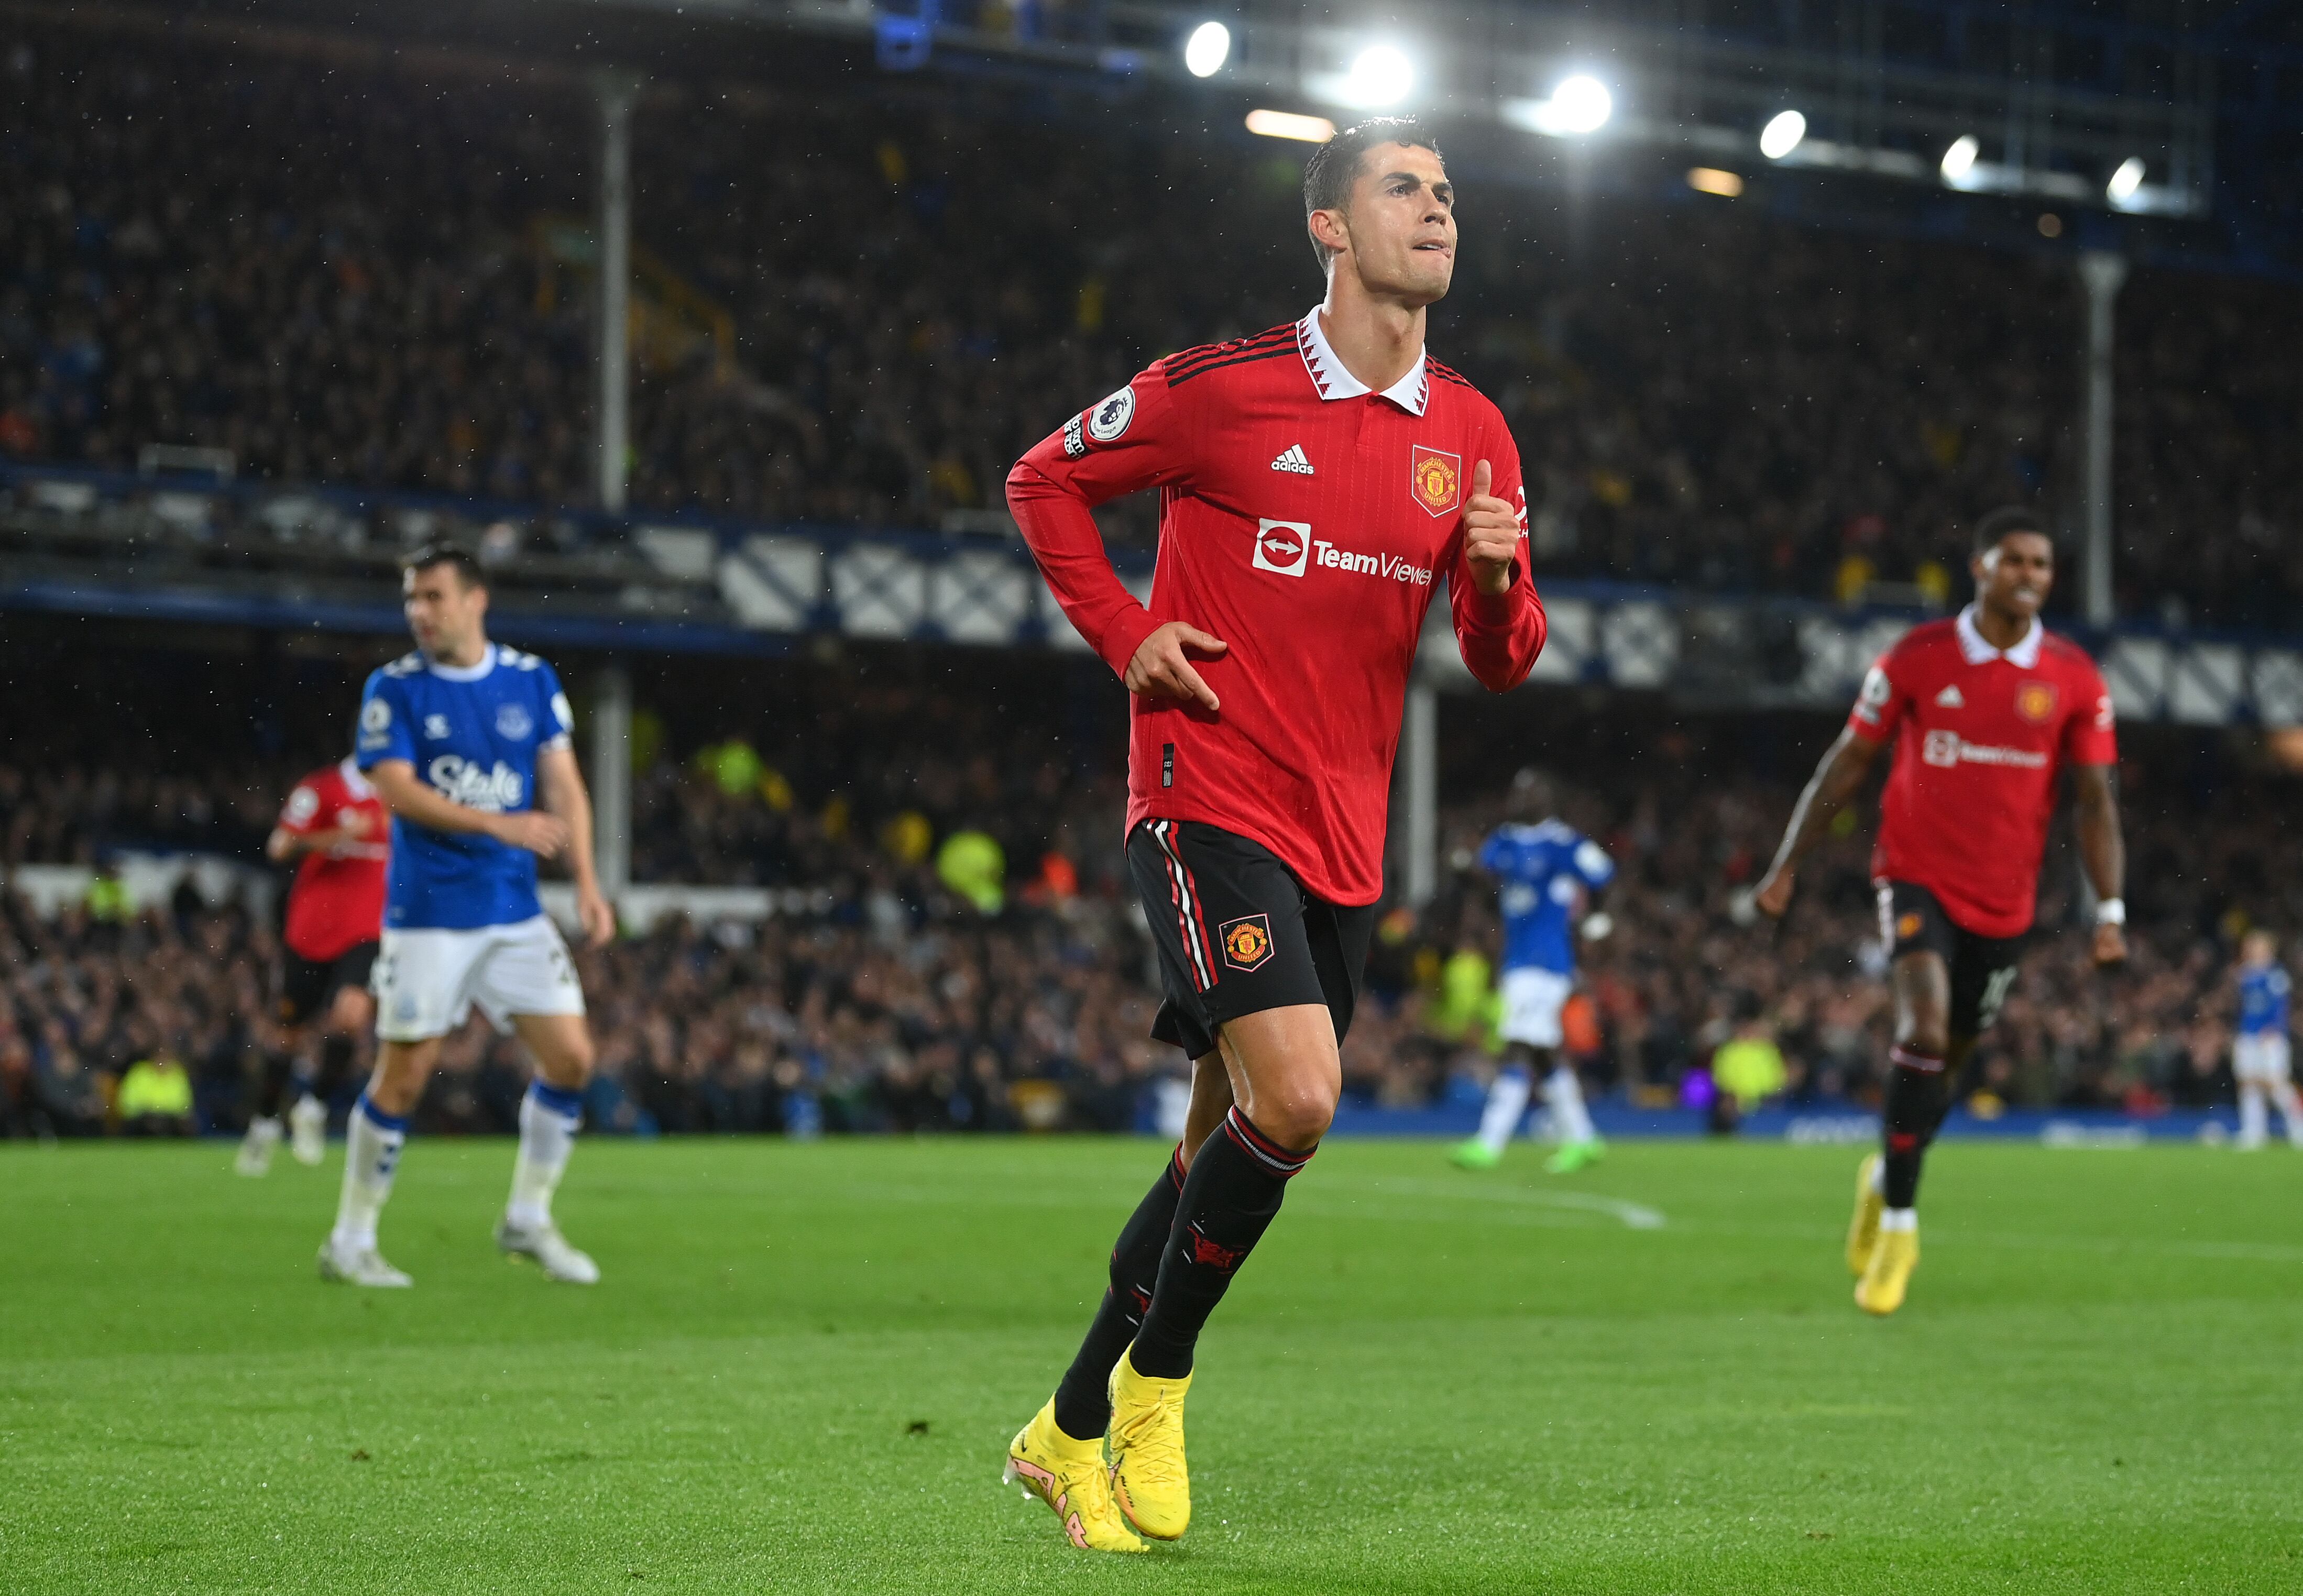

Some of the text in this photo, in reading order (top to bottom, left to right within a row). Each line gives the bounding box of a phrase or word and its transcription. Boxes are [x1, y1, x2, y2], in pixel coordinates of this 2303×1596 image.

[1072, 426, 1085, 454] room
[1271, 461, 1314, 475] adidas
[1420, 460, 1452, 480] MANCHESTER
[1424, 492, 1446, 503] UNITED
[1238, 951, 1260, 960] UNITED
